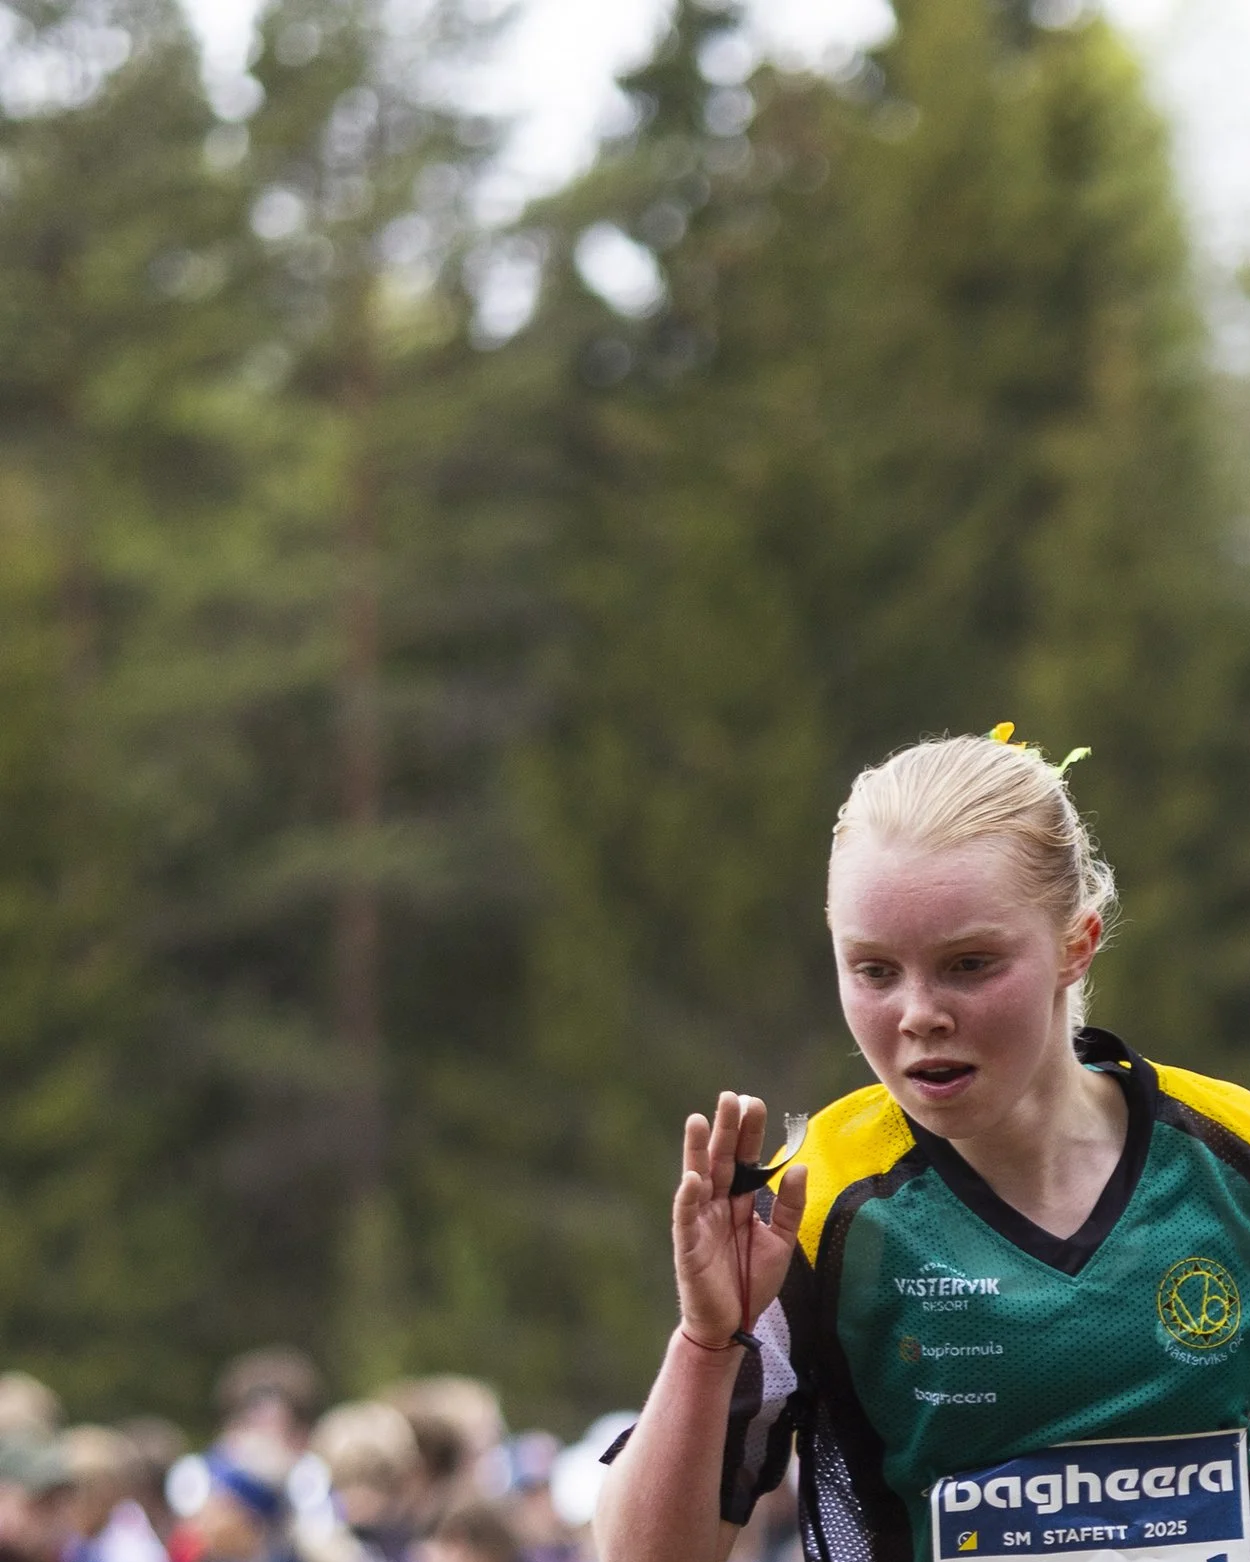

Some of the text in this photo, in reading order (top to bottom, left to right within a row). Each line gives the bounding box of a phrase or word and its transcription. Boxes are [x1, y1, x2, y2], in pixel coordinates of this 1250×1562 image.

[894, 1277, 1001, 1297] VÄSTERVIK
[922, 1300, 969, 1312] RESORT
[921, 1341, 1004, 1359] topformula
[944, 1459, 1234, 1515] bagheera
[1003, 1520, 1188, 1546] SM STAFETT 2025
